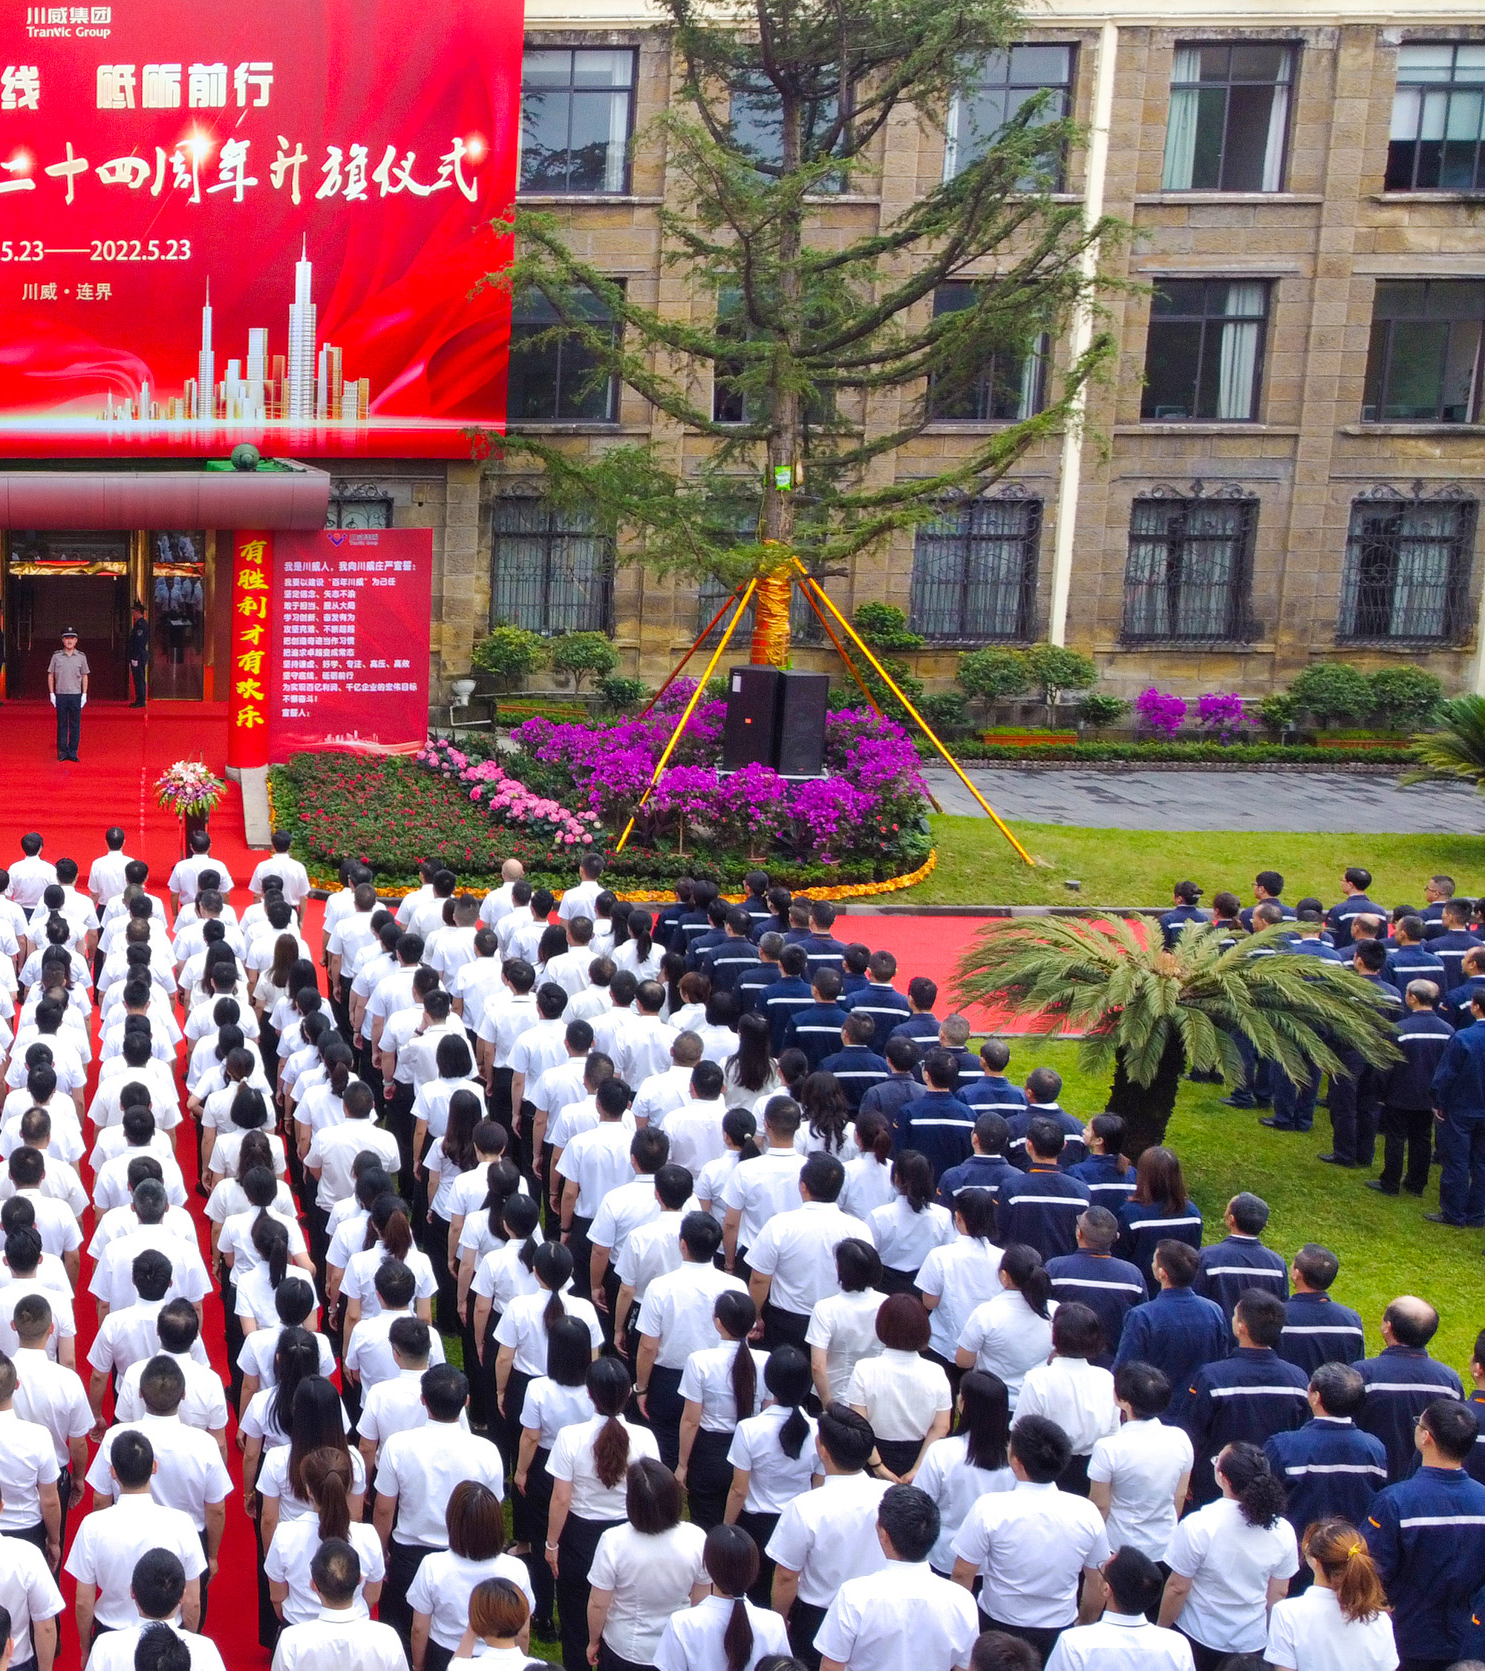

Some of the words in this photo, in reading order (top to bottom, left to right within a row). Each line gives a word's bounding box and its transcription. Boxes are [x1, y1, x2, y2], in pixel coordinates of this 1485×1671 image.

[26, 6, 112, 25] 川威集团
[26, 26, 72, 38] TranVic
[75, 26, 111, 39] Group
[96, 61, 274, 110] 砥砺前行
[236, 539, 270, 729] 有胜利才有欢乐
